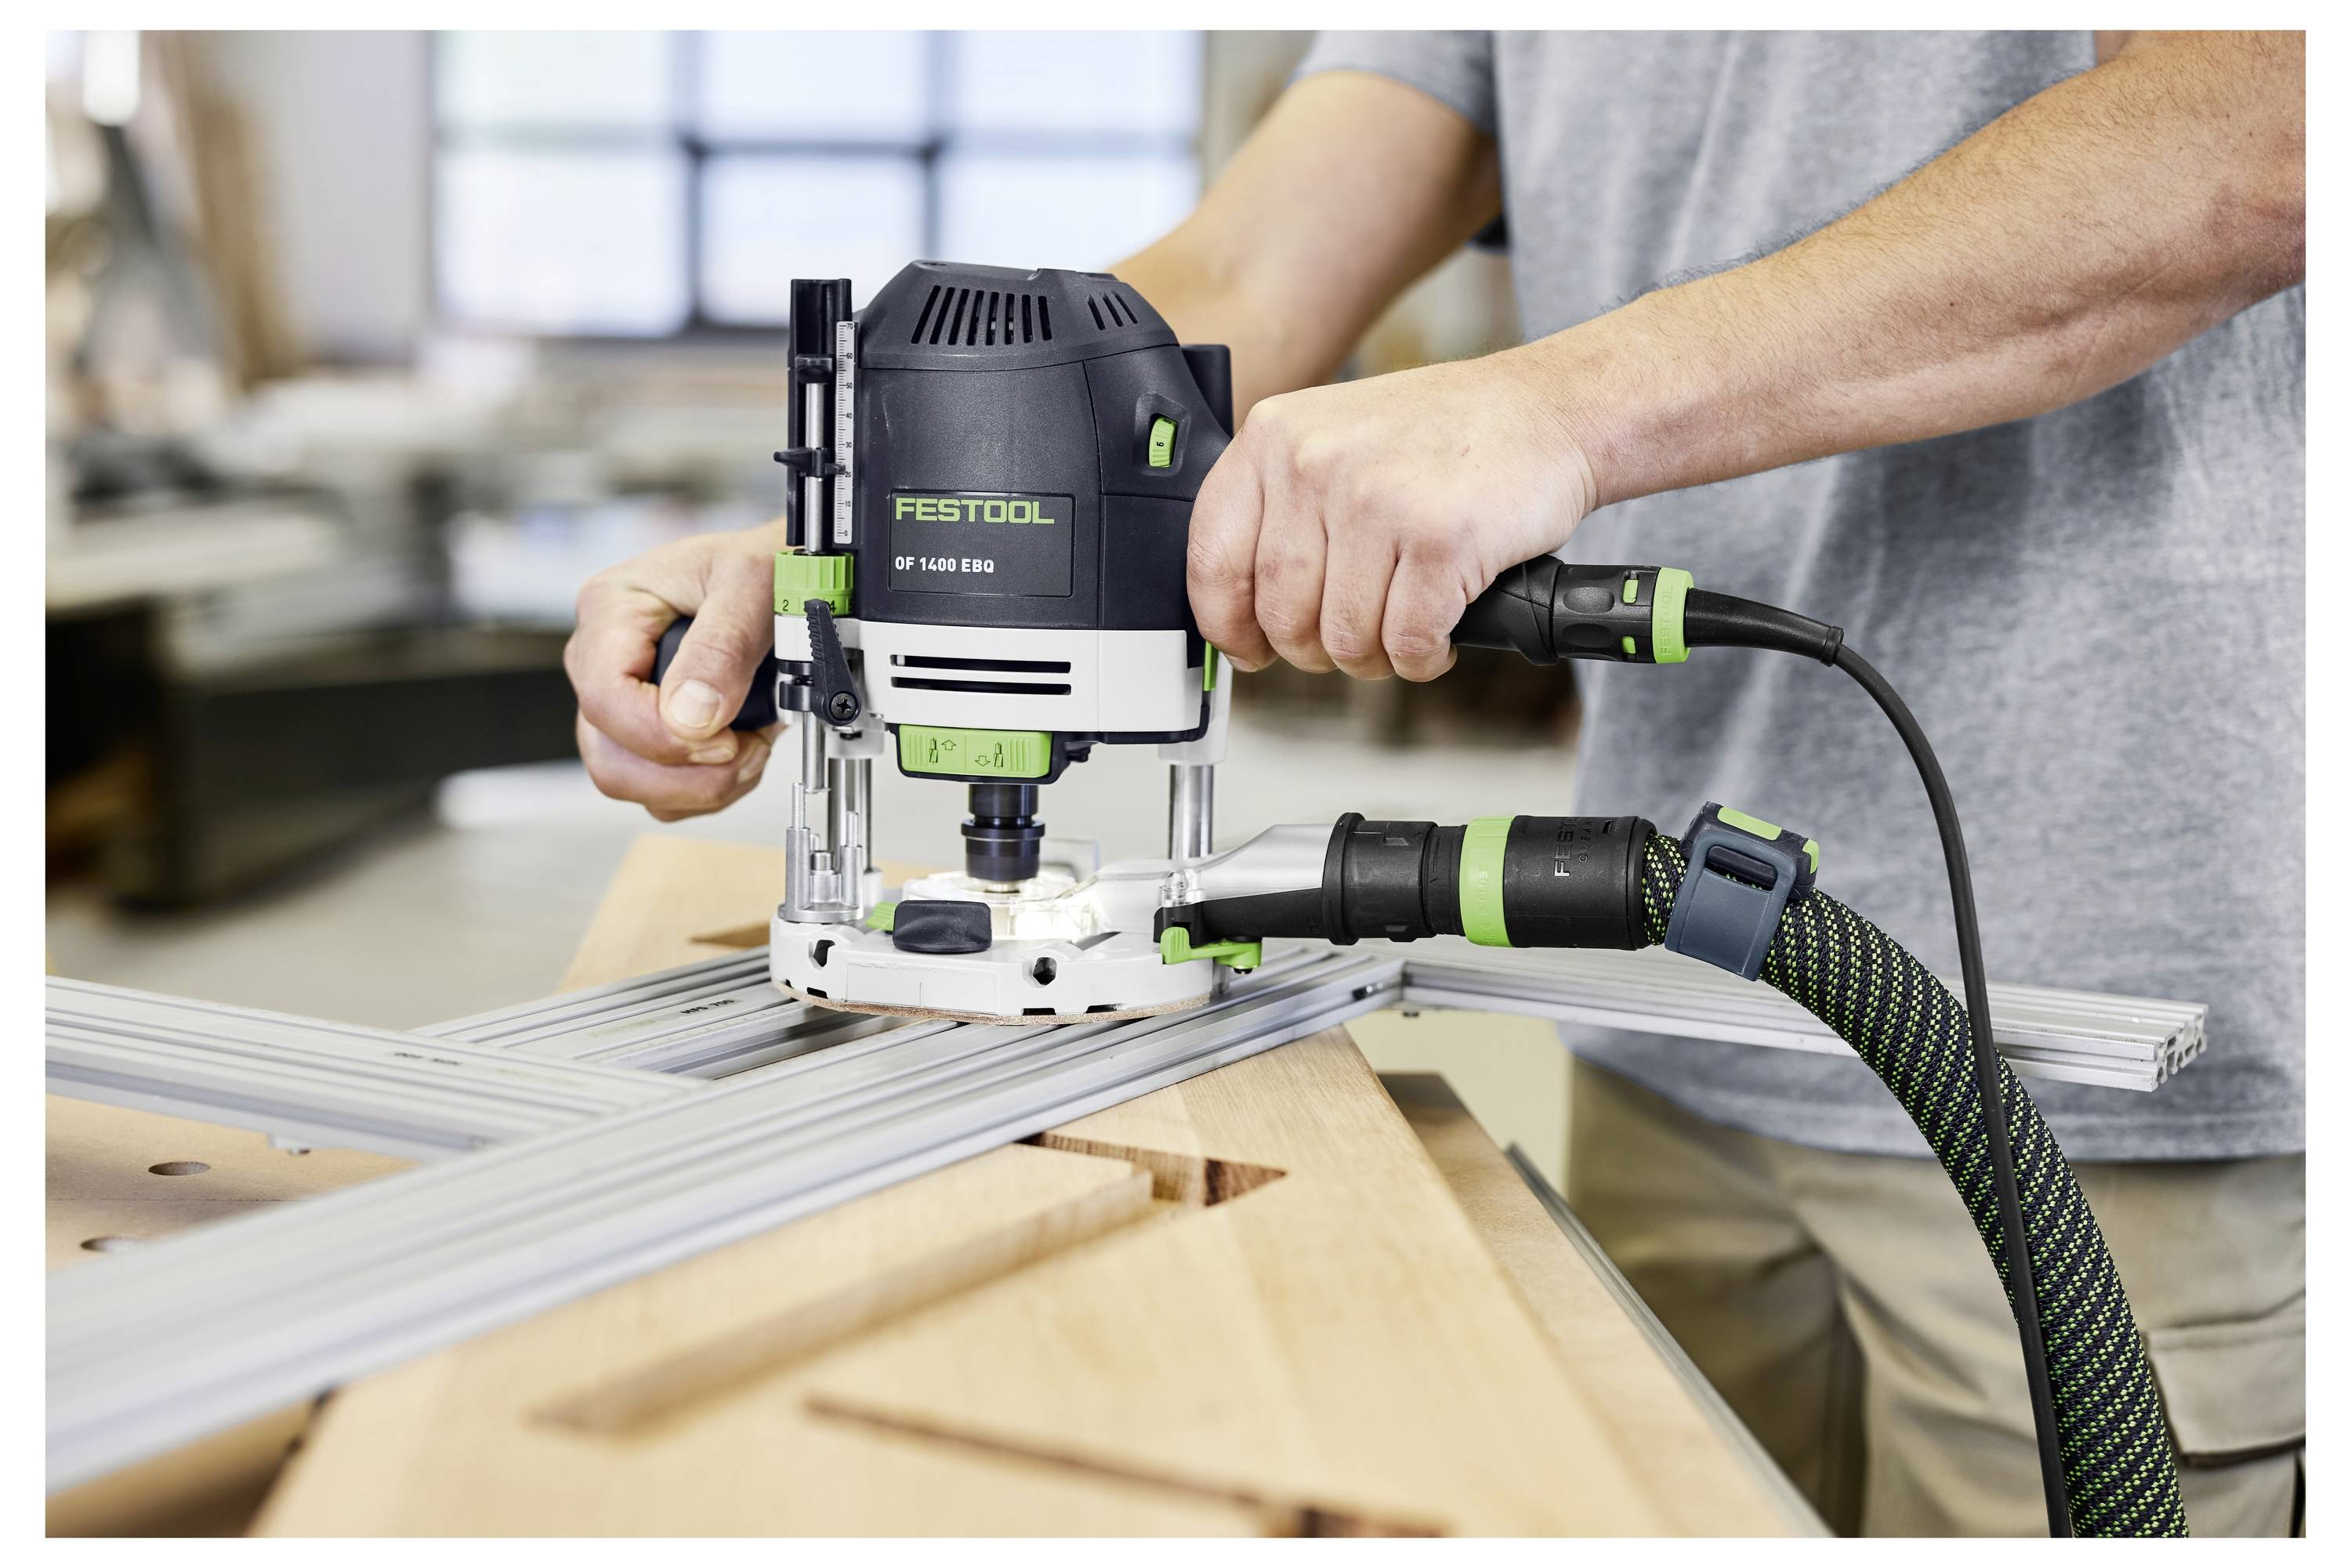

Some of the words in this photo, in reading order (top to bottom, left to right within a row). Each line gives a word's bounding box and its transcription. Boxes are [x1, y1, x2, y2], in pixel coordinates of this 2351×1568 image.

[895, 498, 1055, 524] FESTOOL
[895, 556, 915, 570] OF
[919, 557, 956, 571] 1400
[962, 558, 994, 574] EBQ
[782, 599, 789, 612] 2
[830, 599, 836, 613] 4
[1660, 584, 1674, 654] FESTOOL
